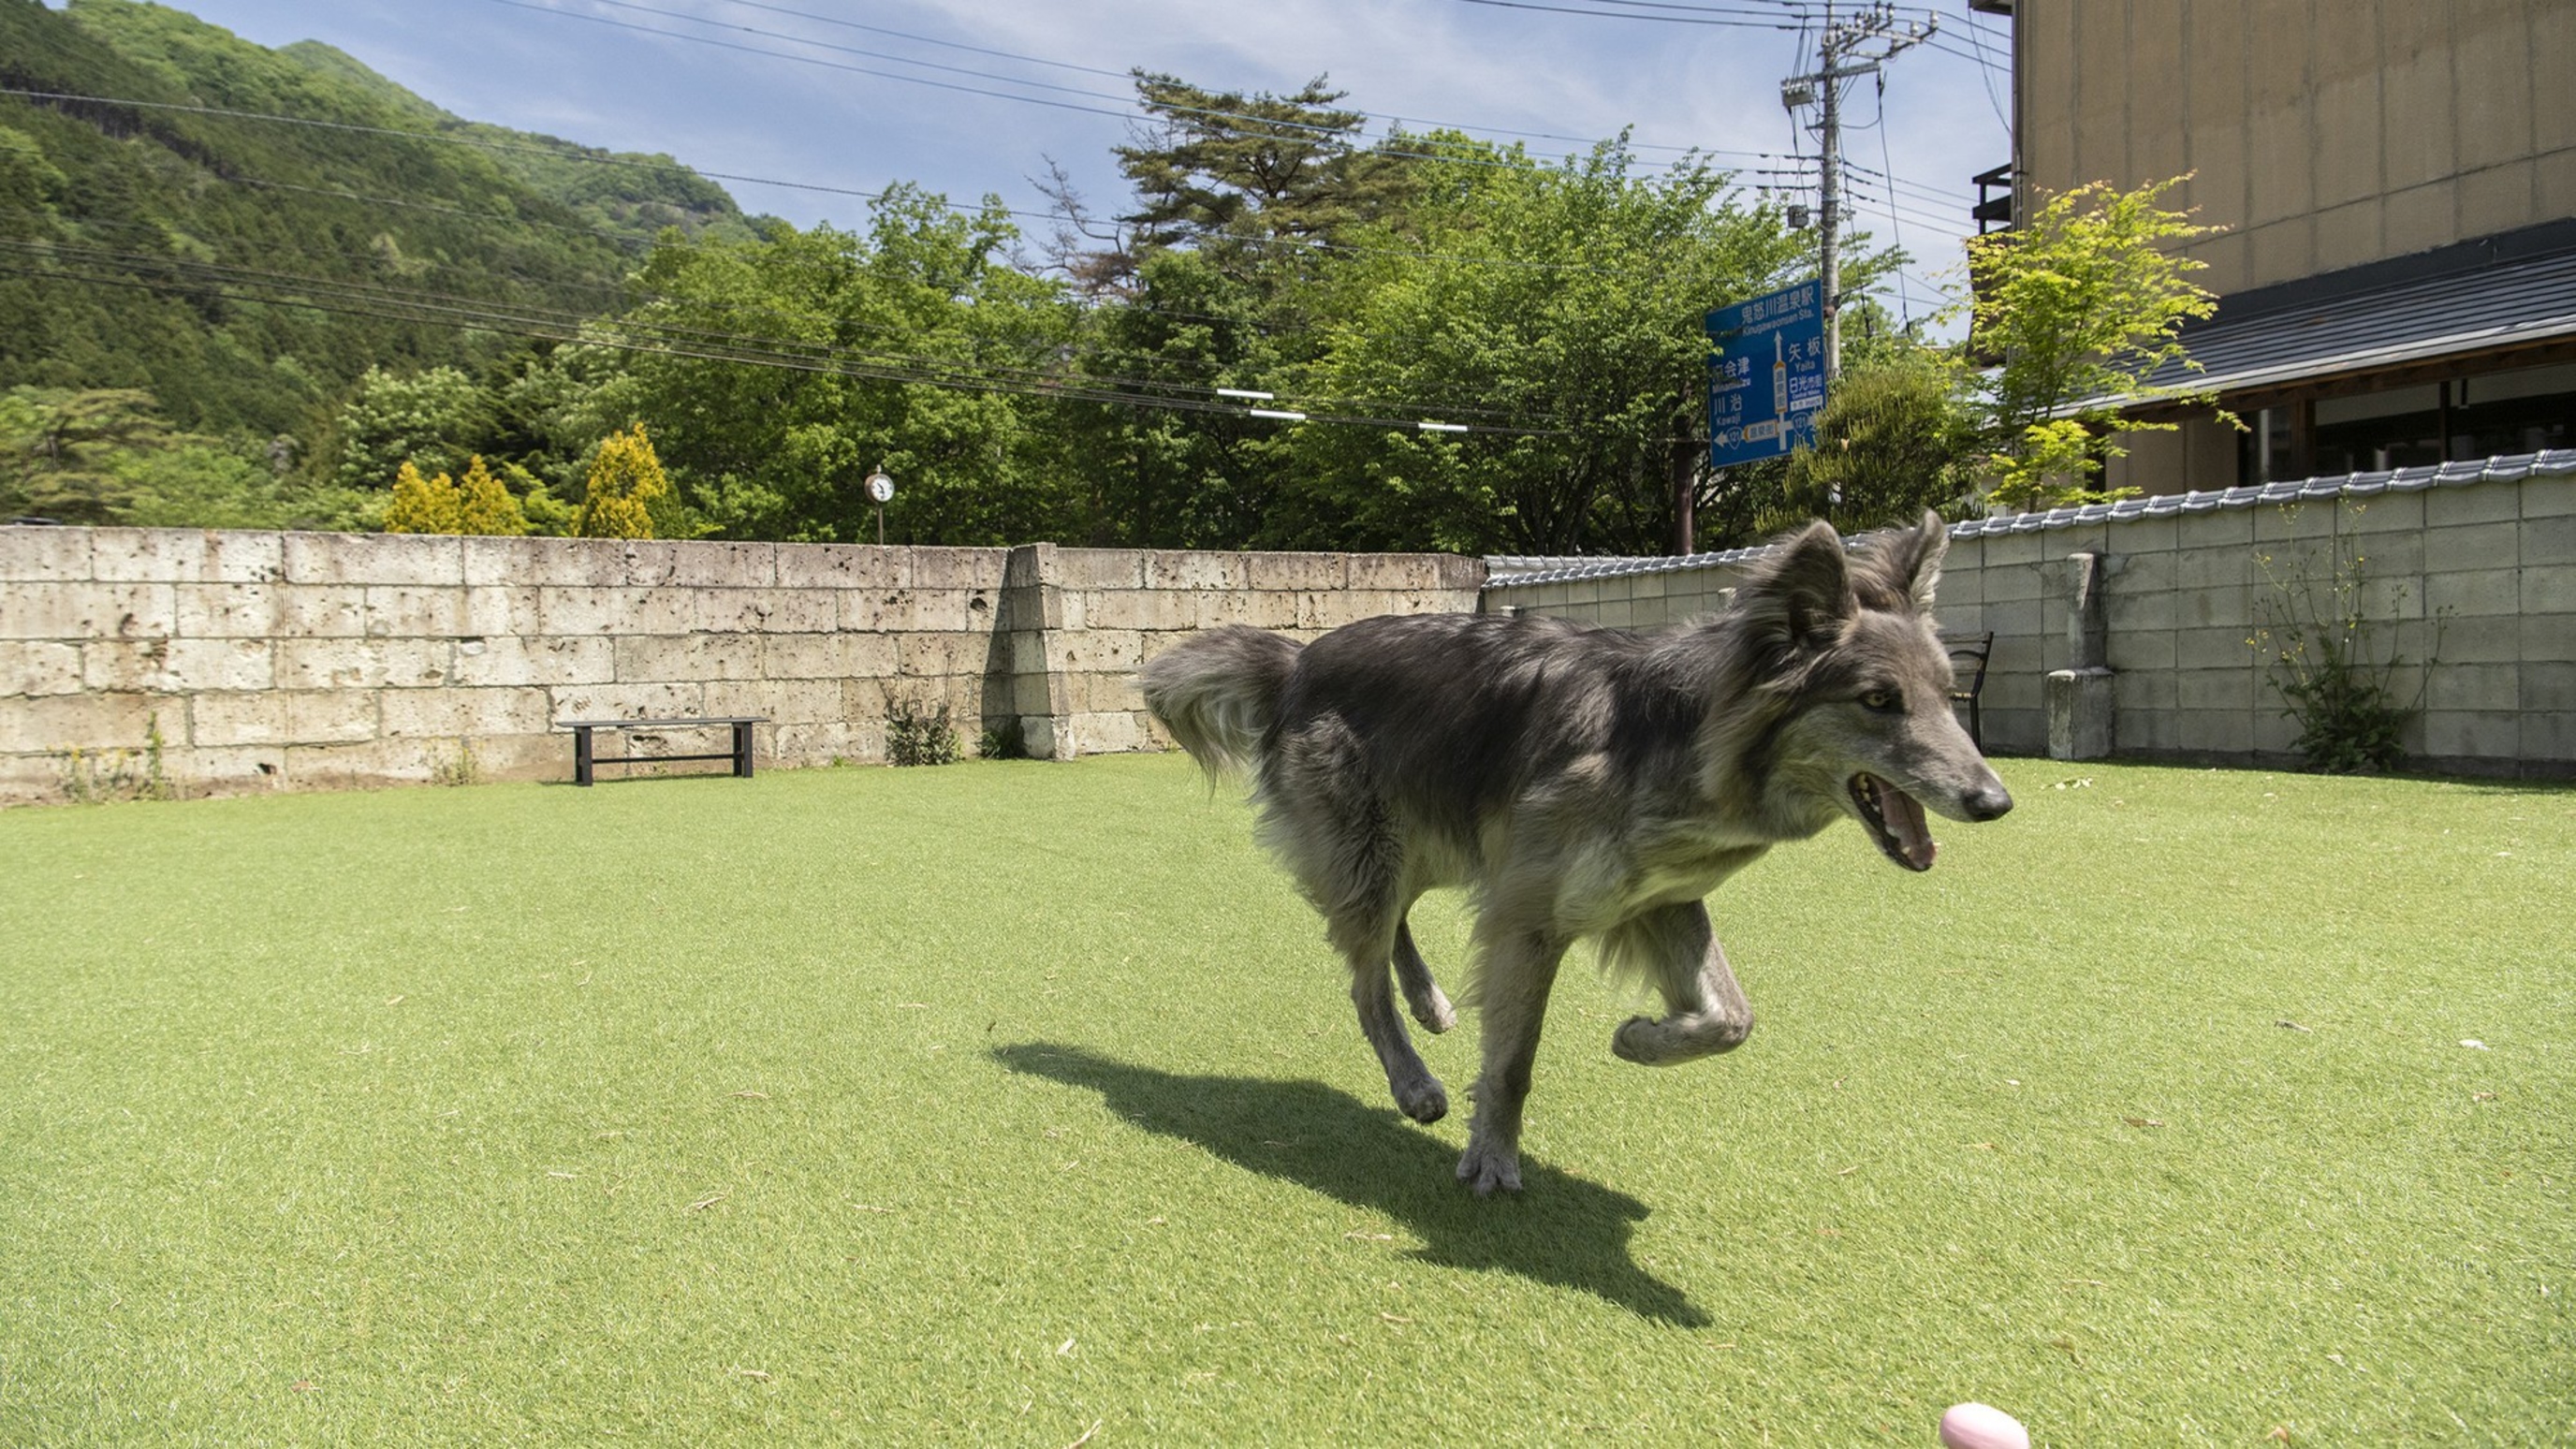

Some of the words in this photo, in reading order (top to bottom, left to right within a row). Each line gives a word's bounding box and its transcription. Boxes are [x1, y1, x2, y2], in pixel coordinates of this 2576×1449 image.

[1742, 285, 1814, 325] 鬼怒川温泉駅
[1798, 308, 1814, 320] Sta.
[1789, 336, 1821, 362] 矢板
[1795, 360, 1815, 373] Yaita
[1714, 393, 1742, 415] 川治
[1716, 413, 1740, 426] Kawaji
[1794, 417, 1806, 428] 121
[1729, 431, 1739, 442] 121
